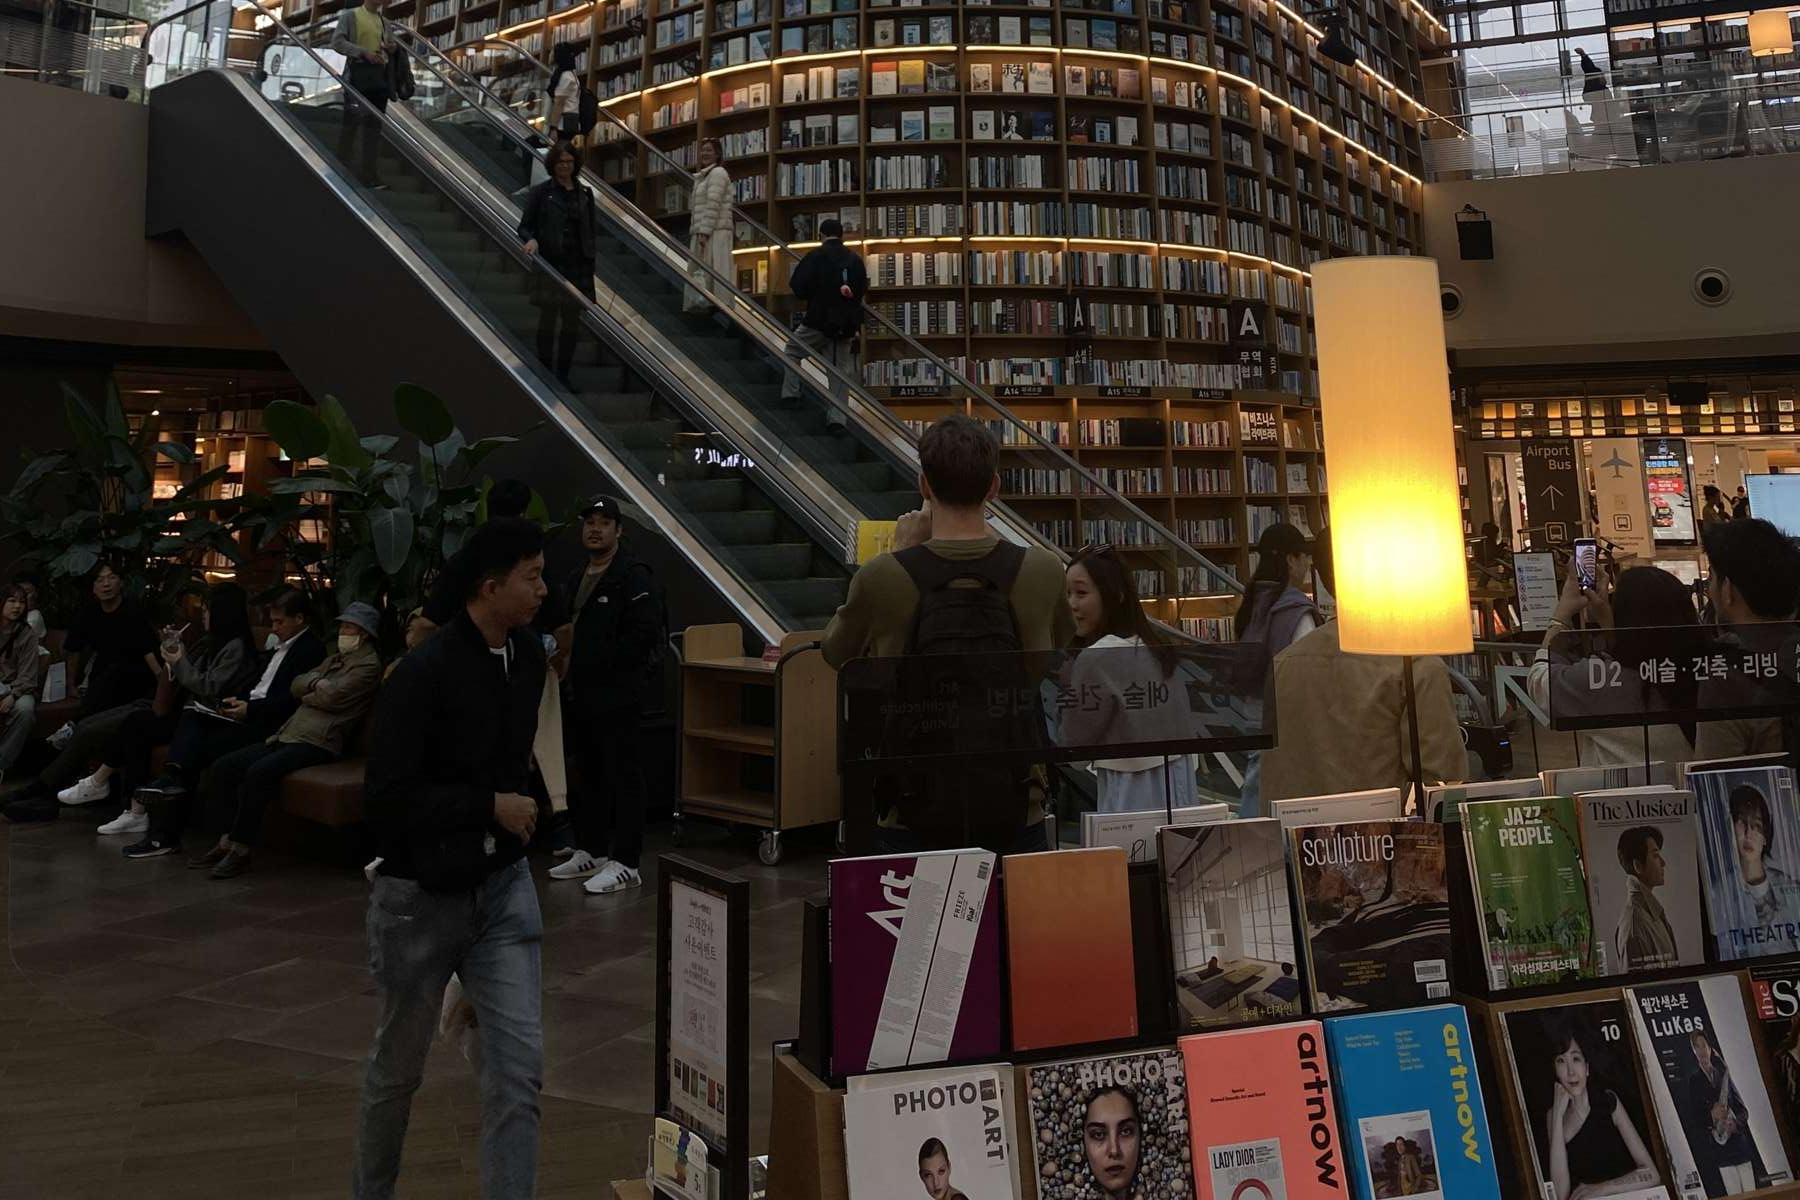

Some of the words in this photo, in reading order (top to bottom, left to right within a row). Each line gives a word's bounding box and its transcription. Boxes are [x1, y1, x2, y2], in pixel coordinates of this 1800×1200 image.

[1074, 297, 1084, 328] A
[1240, 307, 1260, 336] A
[1250, 411, 1276, 427] 비즈니스
[1250, 427, 1278, 441] 라이브러리
[1526, 445, 1571, 462] Airport
[1549, 458, 1573, 471] Bus
[1588, 654, 1623, 690] D2
[1503, 806, 1543, 826] JAZZ
[1589, 802, 1624, 821] The
[1625, 799, 1688, 818] Musical
[1302, 832, 1395, 868] sculpture
[1499, 825, 1554, 847] PEOPLE
[1729, 921, 1800, 948] THEATR
[1760, 985, 1775, 1016] the
[1772, 979, 1800, 1017] S
[1600, 1023, 1621, 1042] 10
[1081, 1059, 1161, 1090] PHOTO
[894, 1082, 977, 1115] PHOTO
[1442, 1023, 1482, 1164] artnow
[1297, 1032, 1339, 1189] artnow
[982, 1105, 1004, 1160] ART
[1213, 1150, 1235, 1169] LADY
[1236, 1148, 1255, 1167] DIOR
